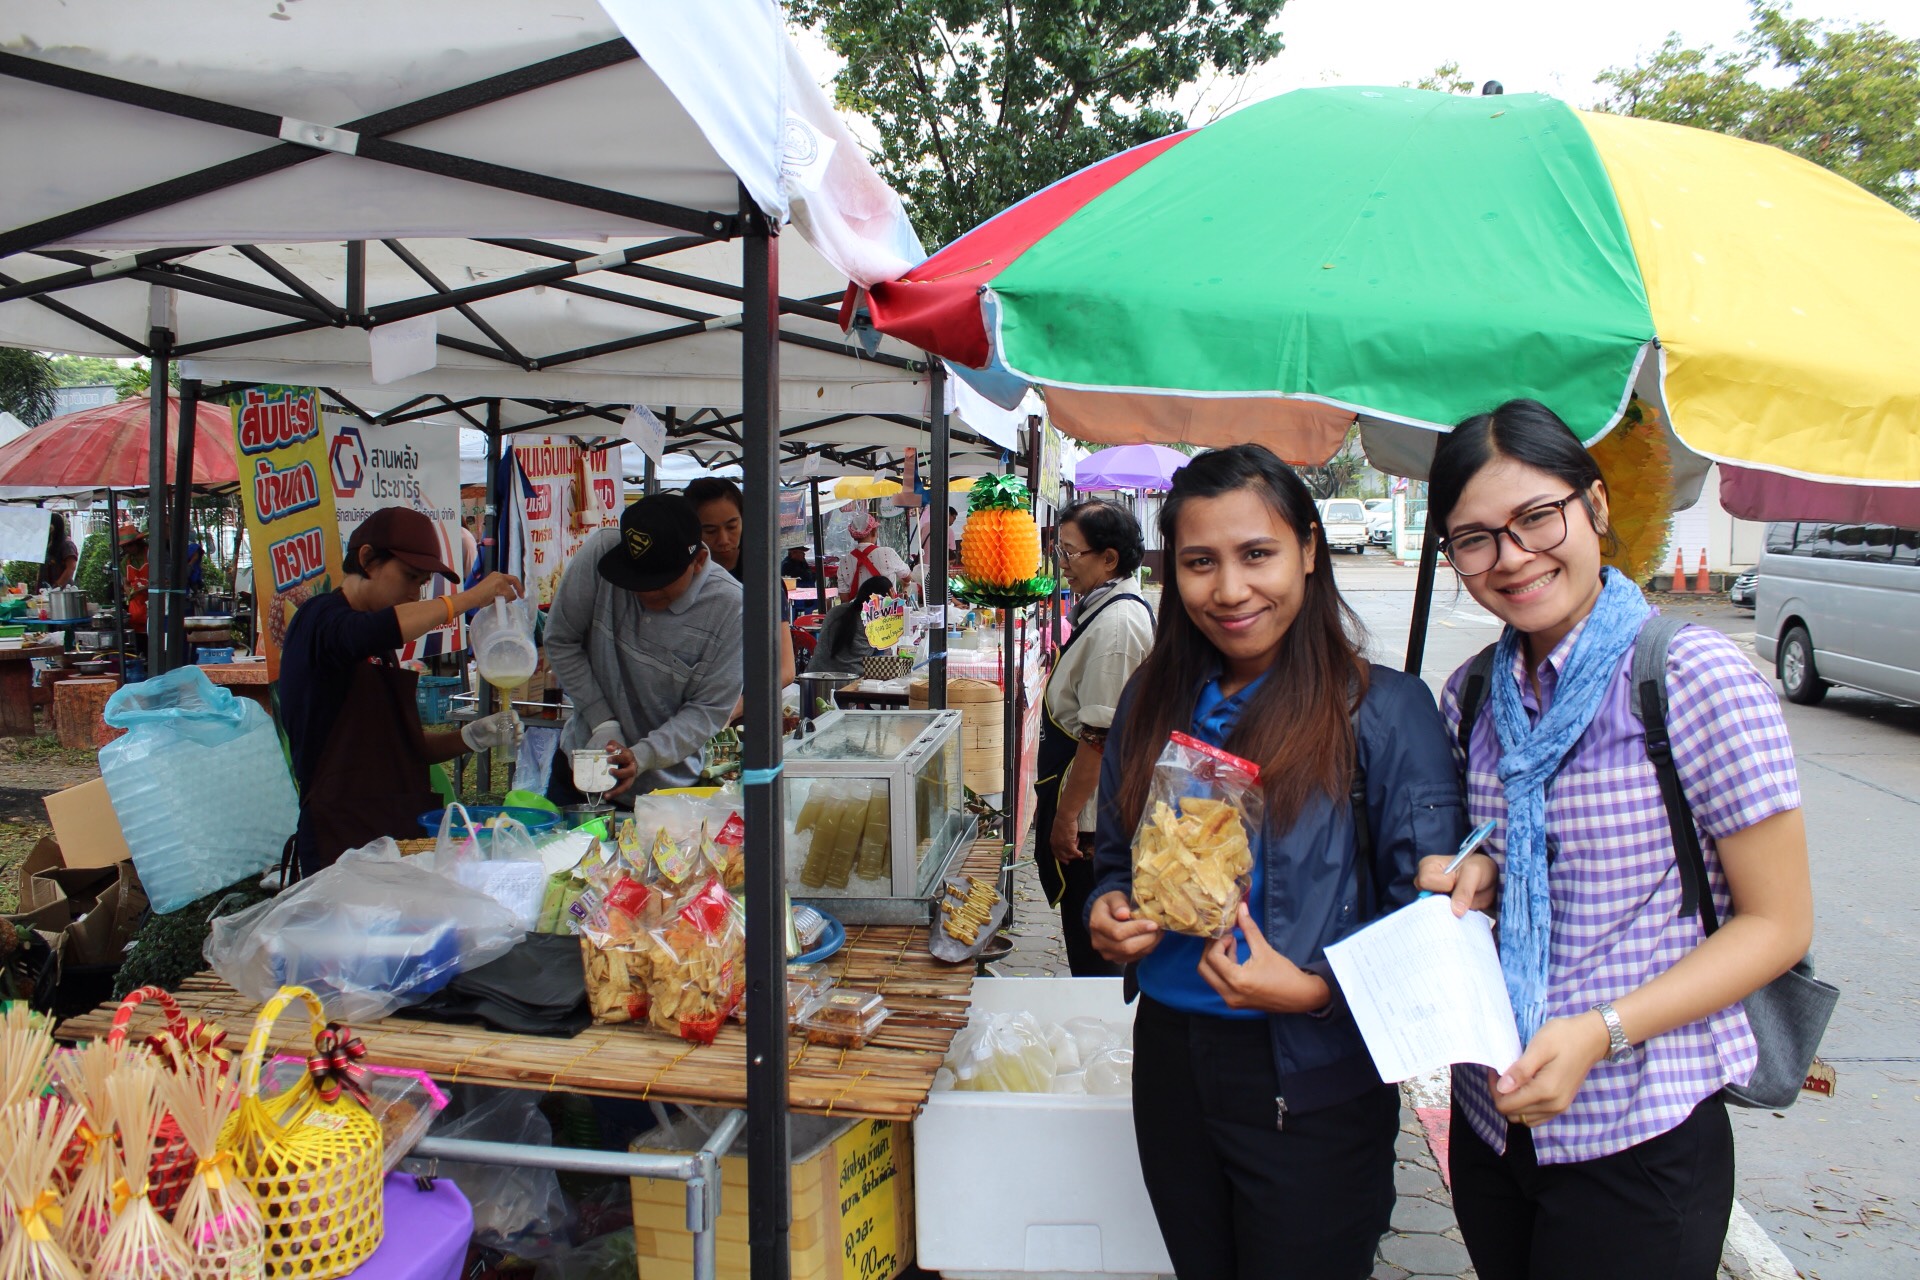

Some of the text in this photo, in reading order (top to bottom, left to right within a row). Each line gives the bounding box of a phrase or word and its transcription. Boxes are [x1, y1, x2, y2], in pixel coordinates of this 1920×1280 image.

[371, 444, 419, 470] สานพลัง
[255, 461, 318, 518] บ้านคา
[371, 472, 421, 506] ประชารัฐ
[271, 530, 325, 587] หวาน
[866, 600, 898, 622] New!
